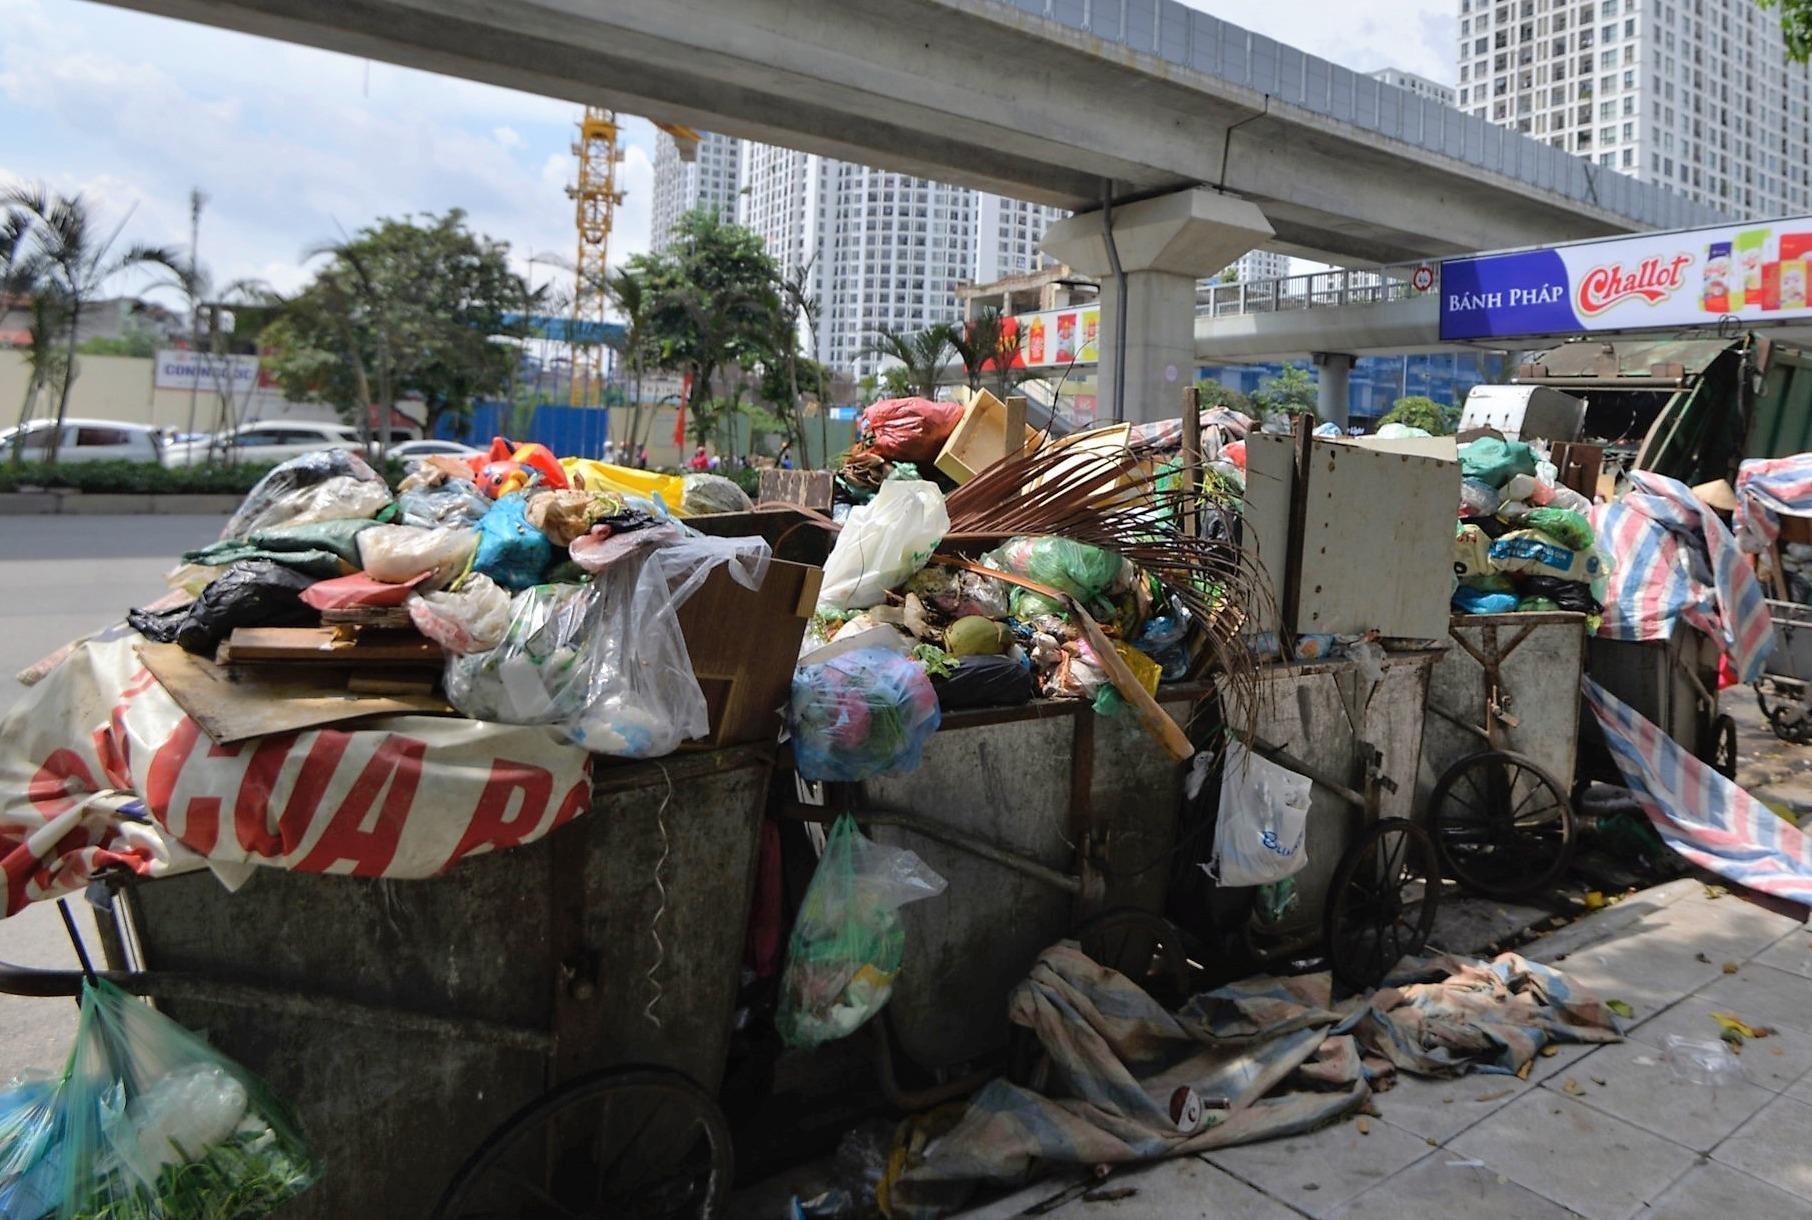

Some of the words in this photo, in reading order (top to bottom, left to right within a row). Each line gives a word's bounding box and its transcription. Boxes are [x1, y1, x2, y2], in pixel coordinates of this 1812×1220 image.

[1449, 292, 1502, 312] BÁNH
[1509, 283, 1563, 306] PHÁP
[1578, 255, 1691, 312] Challot
